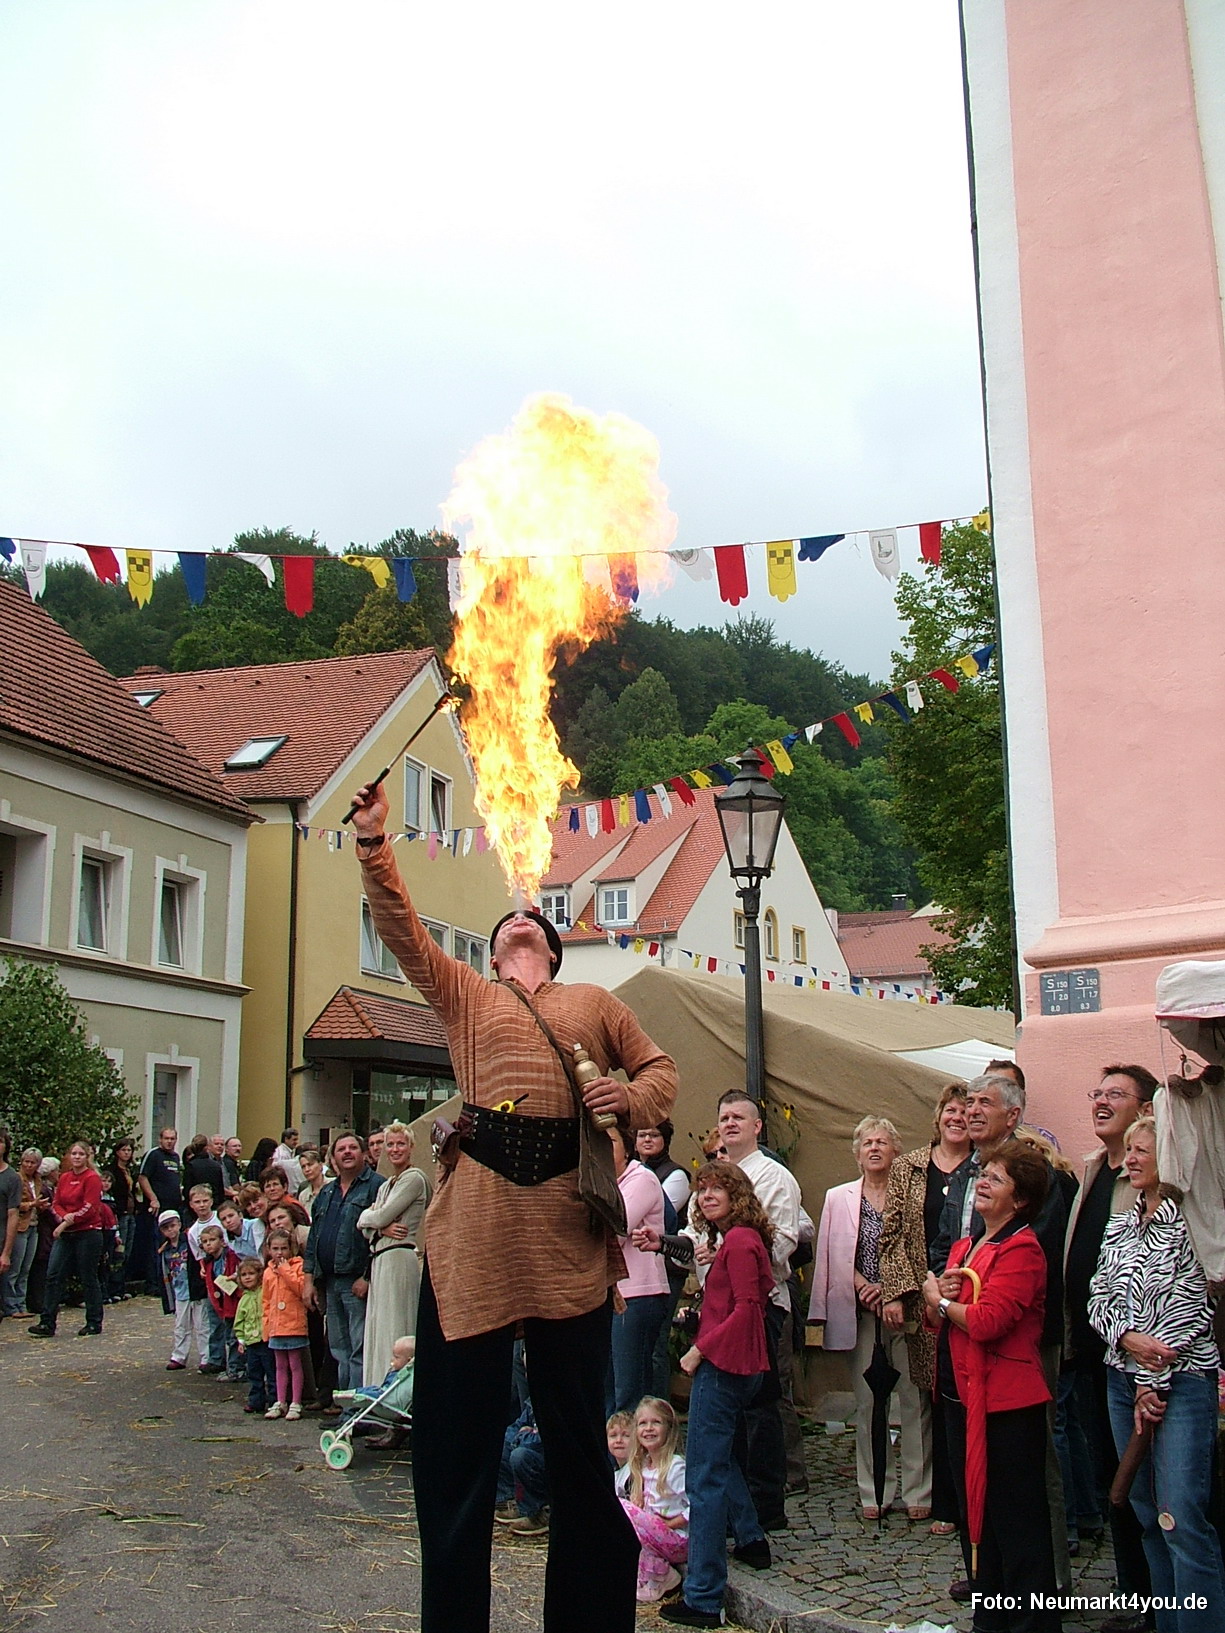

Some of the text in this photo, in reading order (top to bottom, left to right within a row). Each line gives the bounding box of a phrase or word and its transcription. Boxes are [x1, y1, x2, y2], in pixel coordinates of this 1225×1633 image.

[1046, 979, 1055, 989] S
[1076, 976, 1098, 986] S 150
